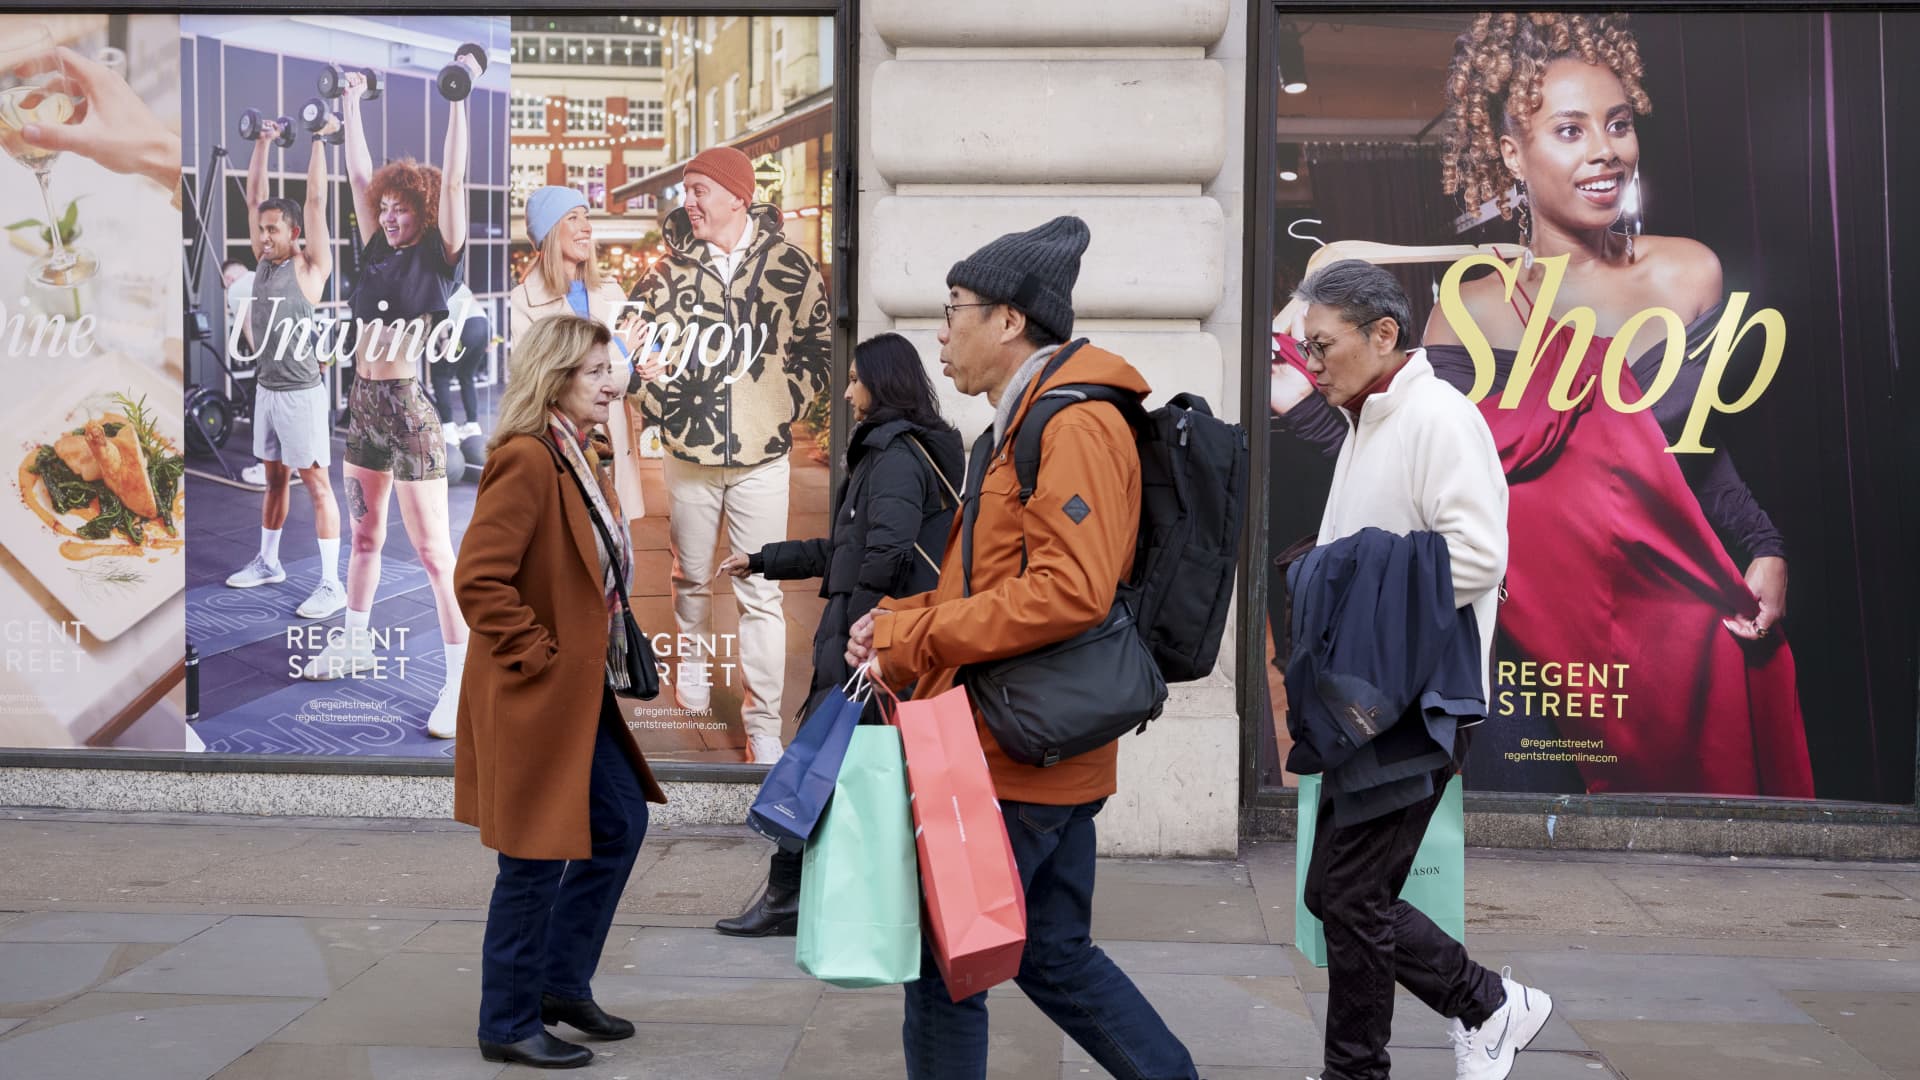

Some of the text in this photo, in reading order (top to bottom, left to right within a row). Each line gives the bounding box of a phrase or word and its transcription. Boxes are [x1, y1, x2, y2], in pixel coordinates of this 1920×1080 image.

[0, 295, 97, 358] ine
[228, 296, 471, 364] Unwind
[604, 301, 769, 384] Enjoy
[1439, 252, 1787, 454] Shop
[4, 620, 86, 644] GENT
[286, 625, 410, 651] REGENT
[642, 632, 737, 658] GENT
[6, 649, 86, 673] REET
[288, 654, 410, 680] STREET
[654, 662, 737, 688] REET
[1498, 660, 1630, 689] REGENT
[295, 712, 402, 724] regentstreetonline.com
[309, 700, 388, 711] @regentstreetw1
[633, 706, 713, 718] @regentstreetw1
[1498, 691, 1629, 719] STREET
[626, 720, 728, 731] gentstreetonline.com
[1504, 751, 1618, 763] regentstreetonline.com
[1520, 738, 1604, 750] @regentstreetw1
[1408, 866, 1440, 877] ASON
